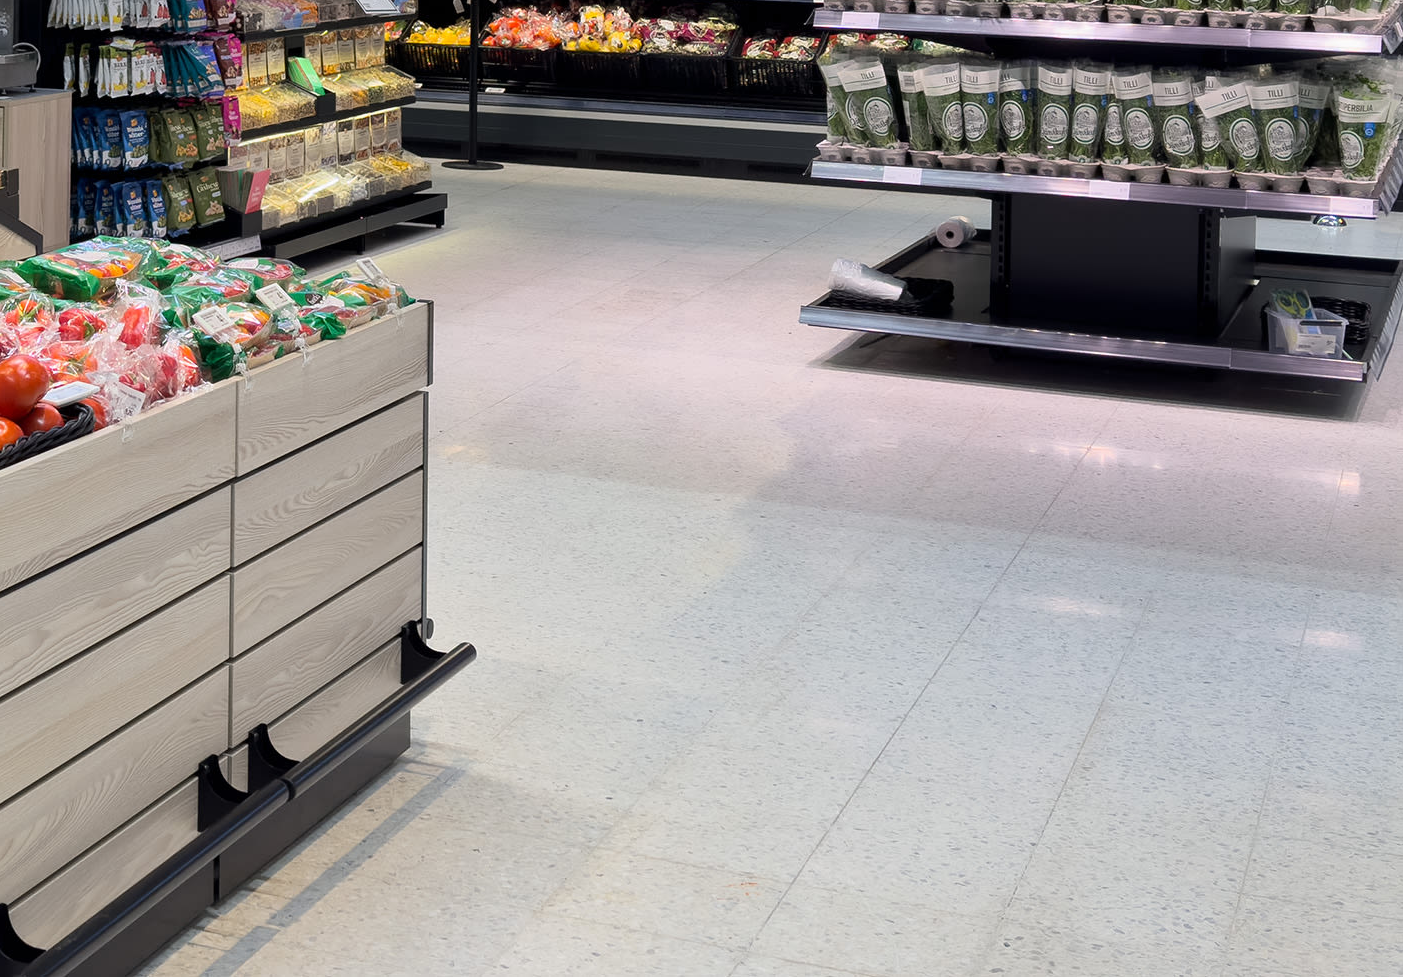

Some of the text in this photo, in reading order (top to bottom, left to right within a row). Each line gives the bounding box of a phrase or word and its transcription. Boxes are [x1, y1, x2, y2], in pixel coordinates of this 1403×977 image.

[860, 72, 875, 80] TILLI
[1049, 75, 1064, 85] TILLI
[1083, 75, 1098, 85] TILLI
[1123, 80, 1139, 89] TILLI
[1164, 86, 1179, 95] TILLI
[1267, 89, 1284, 98] TILLI
[1221, 90, 1238, 102] TILLI
